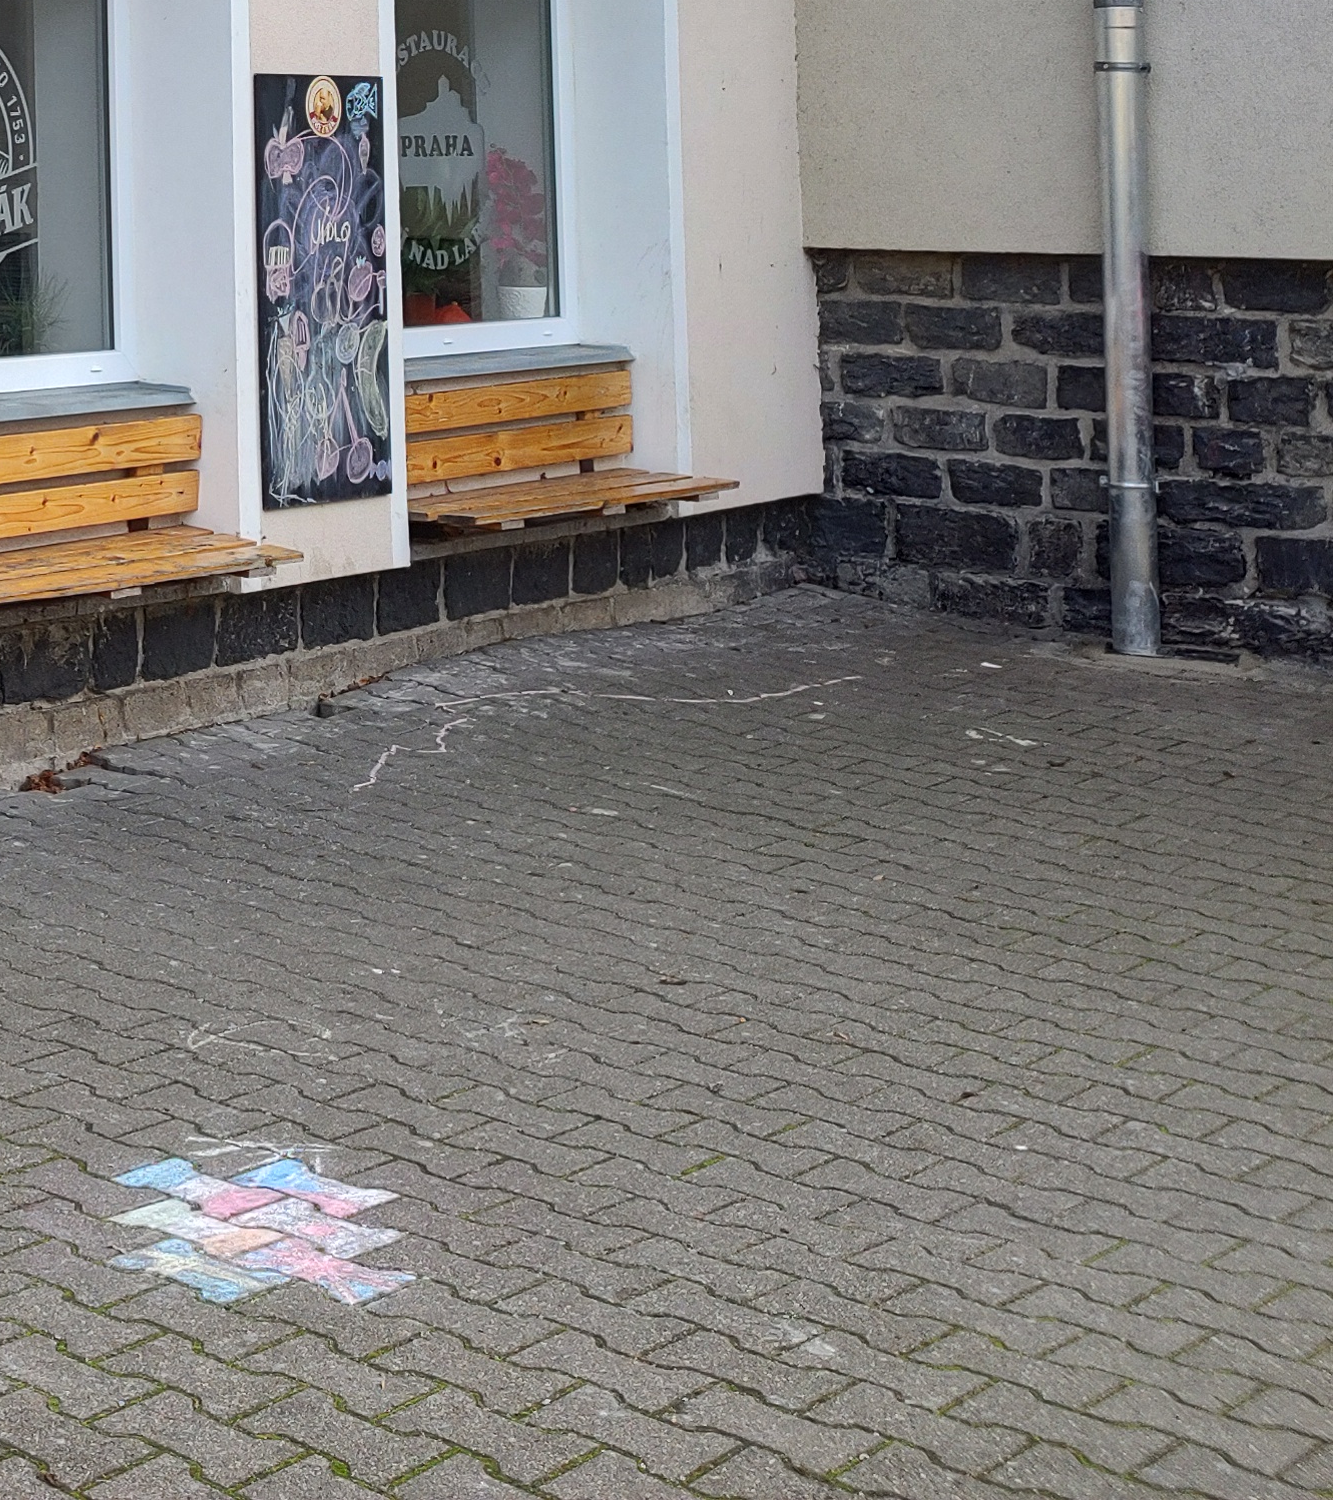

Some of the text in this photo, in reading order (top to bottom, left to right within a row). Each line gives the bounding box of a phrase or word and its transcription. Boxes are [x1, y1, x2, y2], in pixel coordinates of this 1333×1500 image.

[5, 94, 26, 145] 1753
[400, 134, 474, 158] PRAHA
[408, 240, 450, 270] NAD
